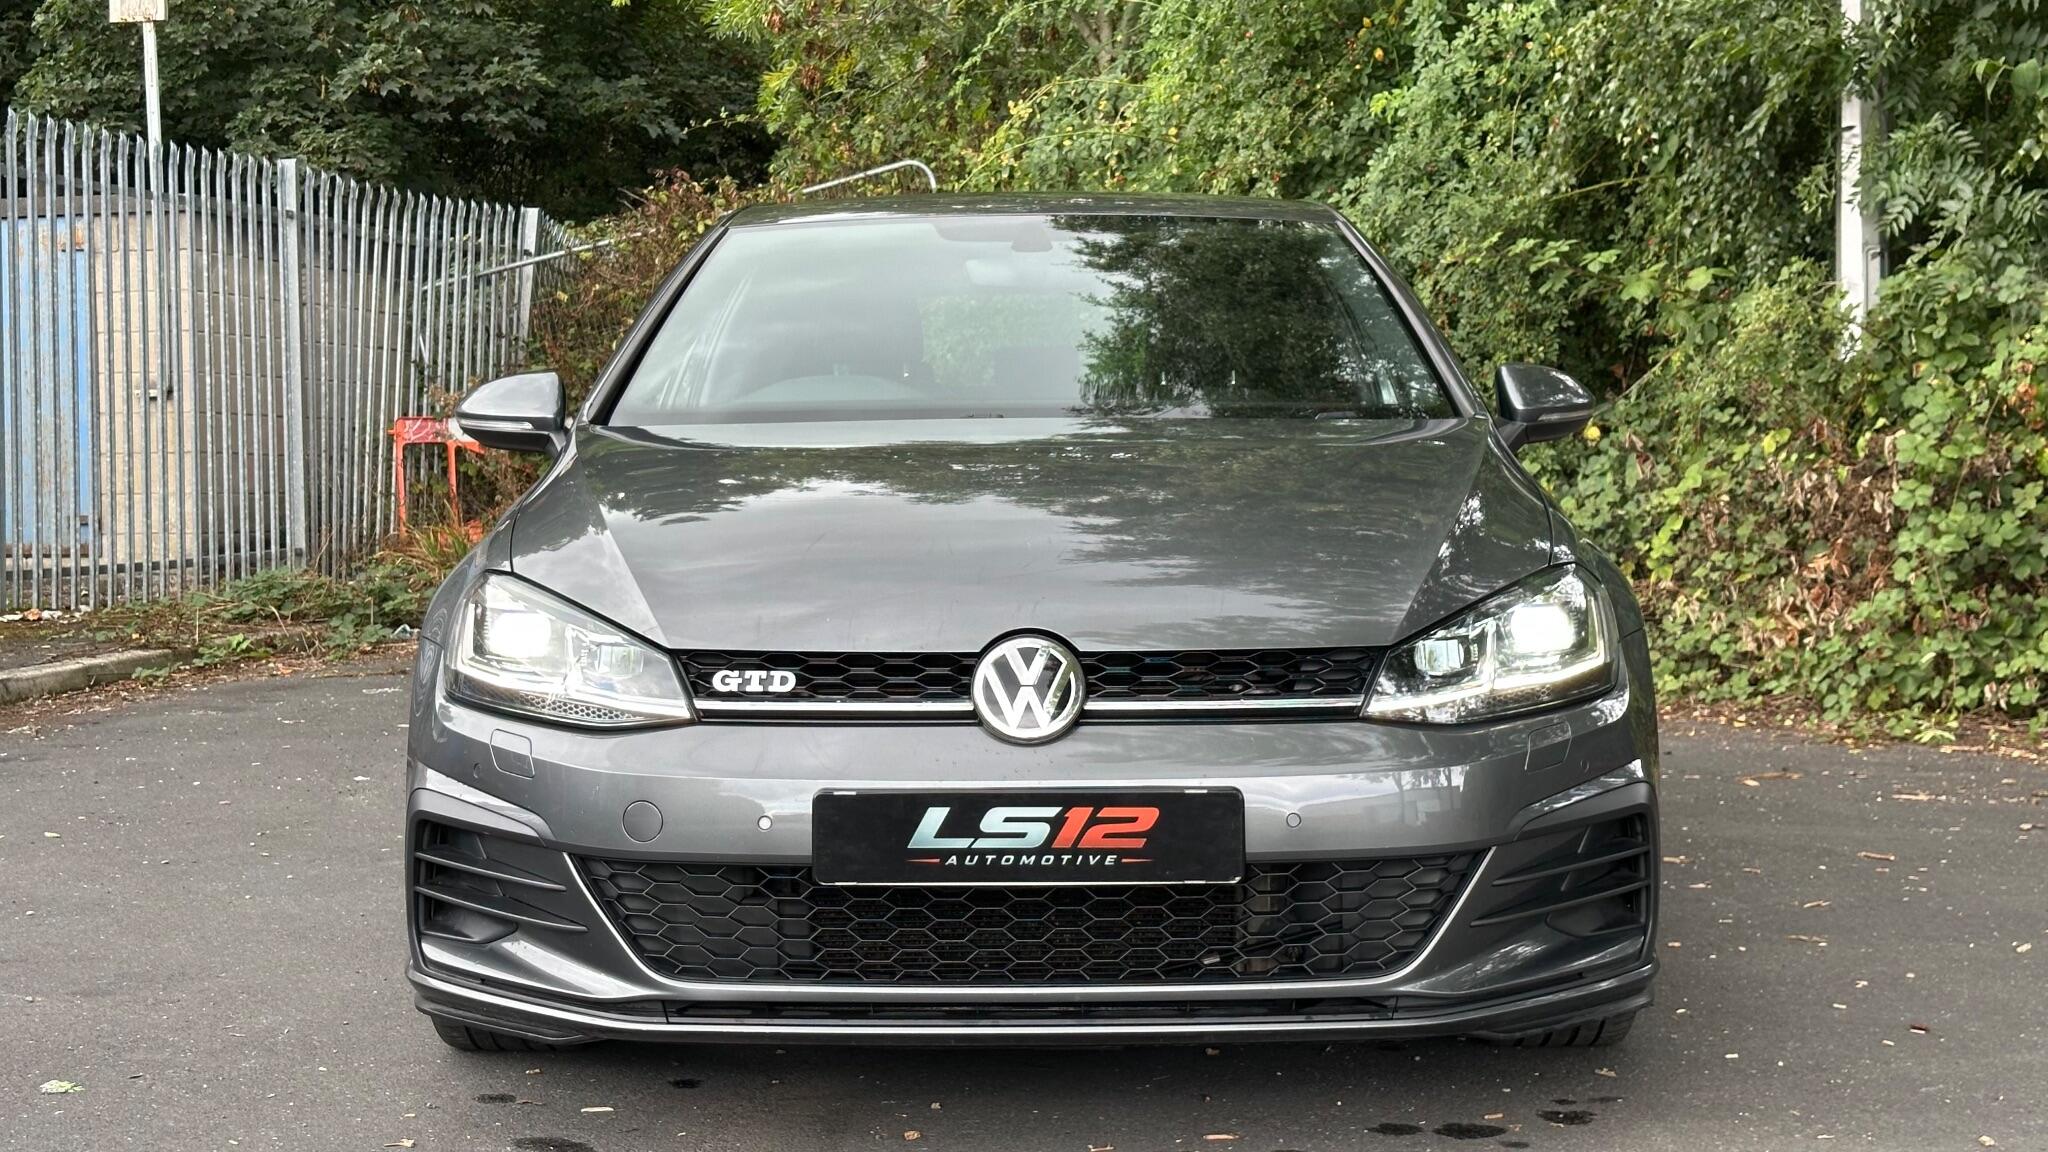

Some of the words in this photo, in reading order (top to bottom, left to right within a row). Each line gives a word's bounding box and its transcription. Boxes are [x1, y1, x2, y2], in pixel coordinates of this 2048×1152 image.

[712, 670, 797, 693] GTD
[977, 638, 1081, 737] VW
[907, 807, 1160, 848] LS12
[944, 855, 1118, 866] AUTOMOTIVE
